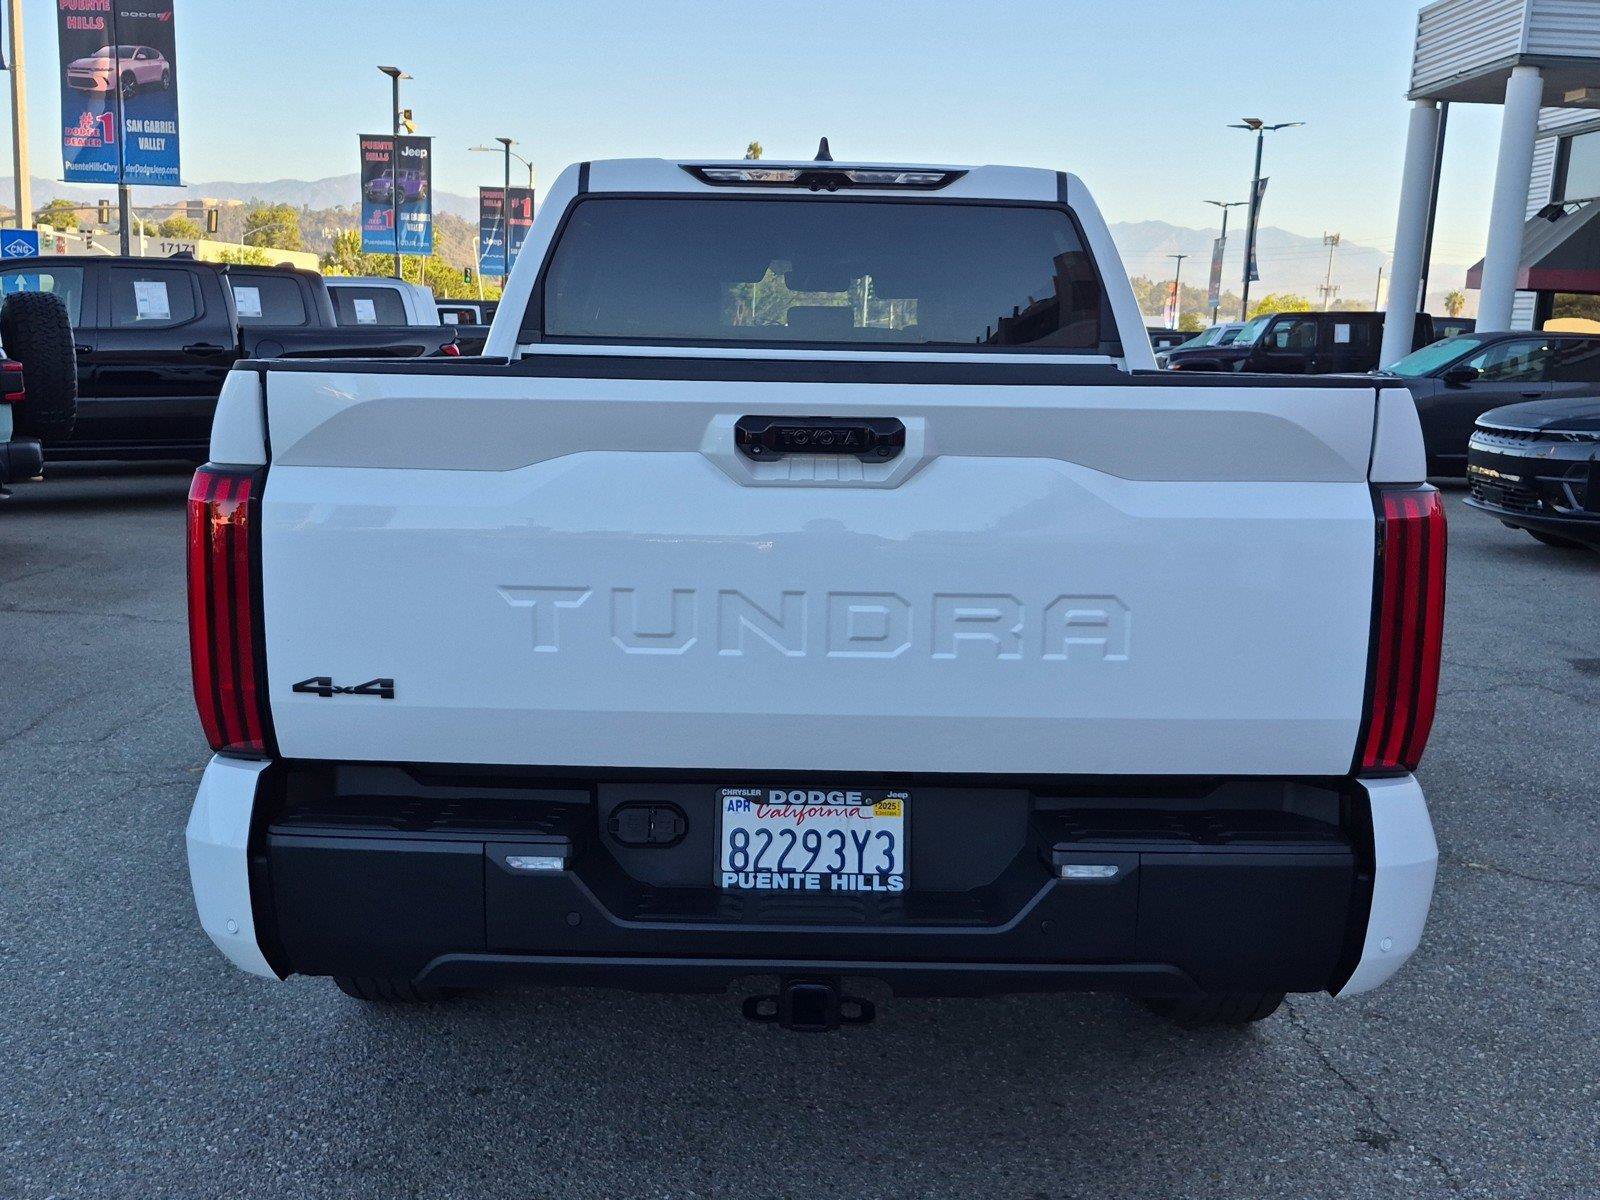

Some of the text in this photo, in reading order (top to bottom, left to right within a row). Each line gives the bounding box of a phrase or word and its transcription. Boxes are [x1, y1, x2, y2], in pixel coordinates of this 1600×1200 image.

[66, 16, 104, 30] HILLS
[126, 119, 176, 134] SAN GABRIEL
[138, 137, 166, 150] VALLEY
[401, 146, 428, 158] Jeep
[10, 245, 30, 254] CNG
[160, 242, 196, 255] 17171
[780, 429, 860, 446] TOYOTA
[497, 584, 1132, 662] TUNDRA
[292, 676, 394, 699] 4x4
[721, 788, 762, 797] CHRYSLER
[769, 790, 862, 805] DODGE
[887, 791, 909, 799] Jeep
[727, 799, 751, 812] APR
[878, 802, 897, 810] 2025
[756, 802, 874, 826] California
[729, 827, 895, 874] 82293Y3
[722, 872, 904, 891] PUENTE HILLS
